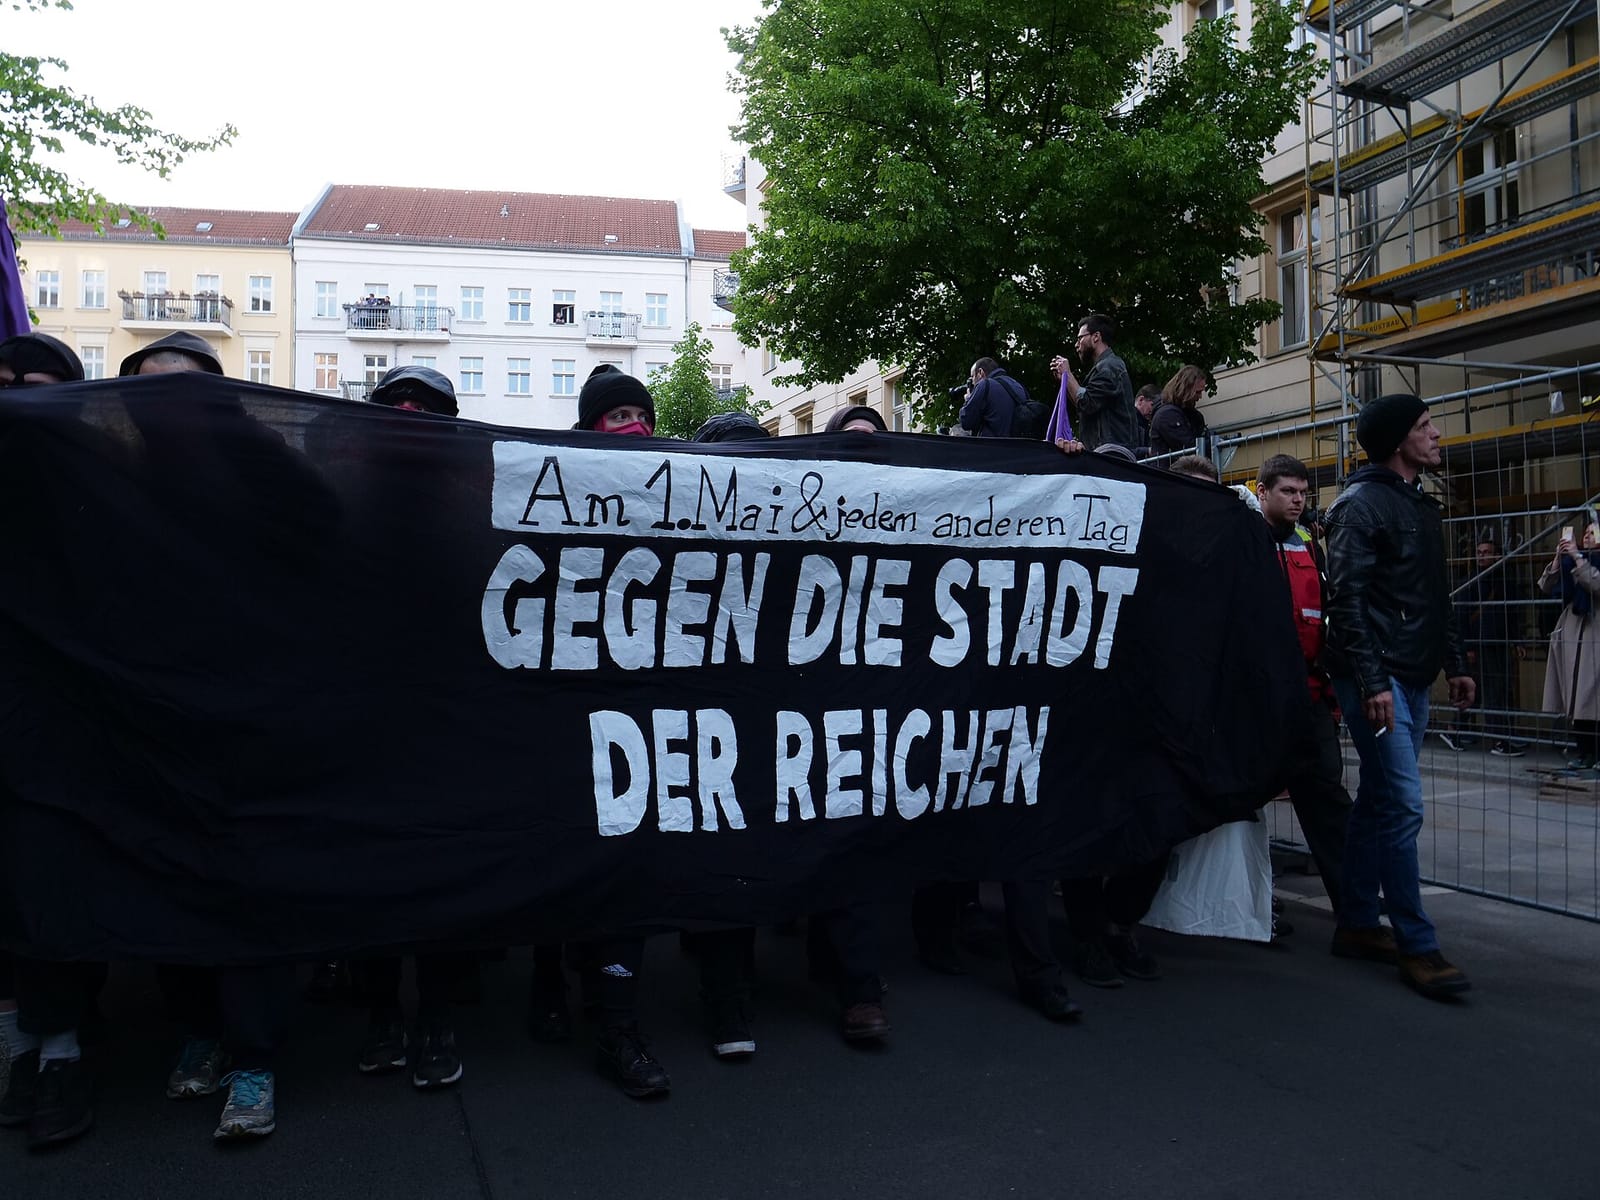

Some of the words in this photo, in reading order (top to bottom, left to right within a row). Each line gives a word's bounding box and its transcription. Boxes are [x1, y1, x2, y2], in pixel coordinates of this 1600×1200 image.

[517, 456, 630, 527] Am
[825, 492, 917, 540] jedem
[931, 495, 1067, 539] anderen
[1073, 494, 1129, 553] Tag
[482, 544, 770, 670] GEGEN
[788, 555, 911, 667] DIE
[929, 557, 1139, 669] STADT
[589, 709, 746, 836] DER
[775, 705, 1050, 822] REICHEN
